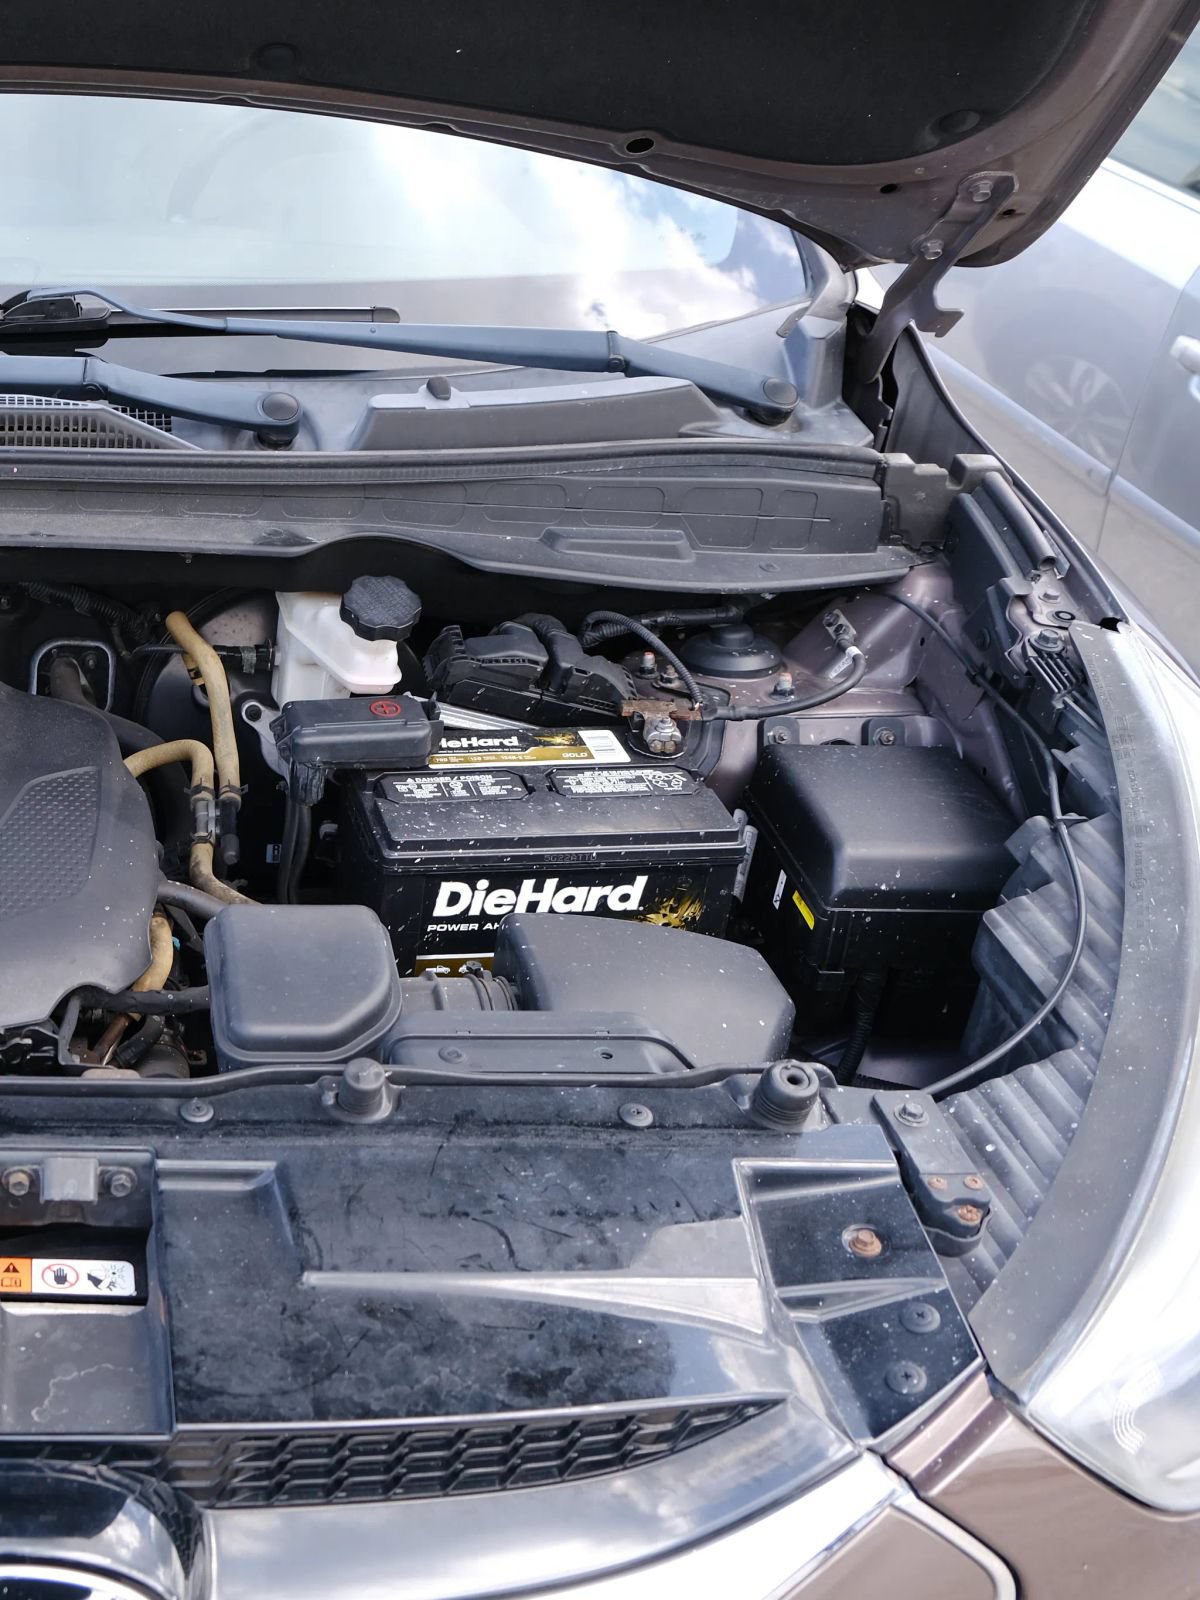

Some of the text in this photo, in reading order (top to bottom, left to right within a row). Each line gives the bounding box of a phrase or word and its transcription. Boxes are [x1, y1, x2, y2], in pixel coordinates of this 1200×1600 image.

[439, 736, 519, 749] ieHard
[432, 875, 648, 917] DieHard
[426, 923, 479, 932] POWER
